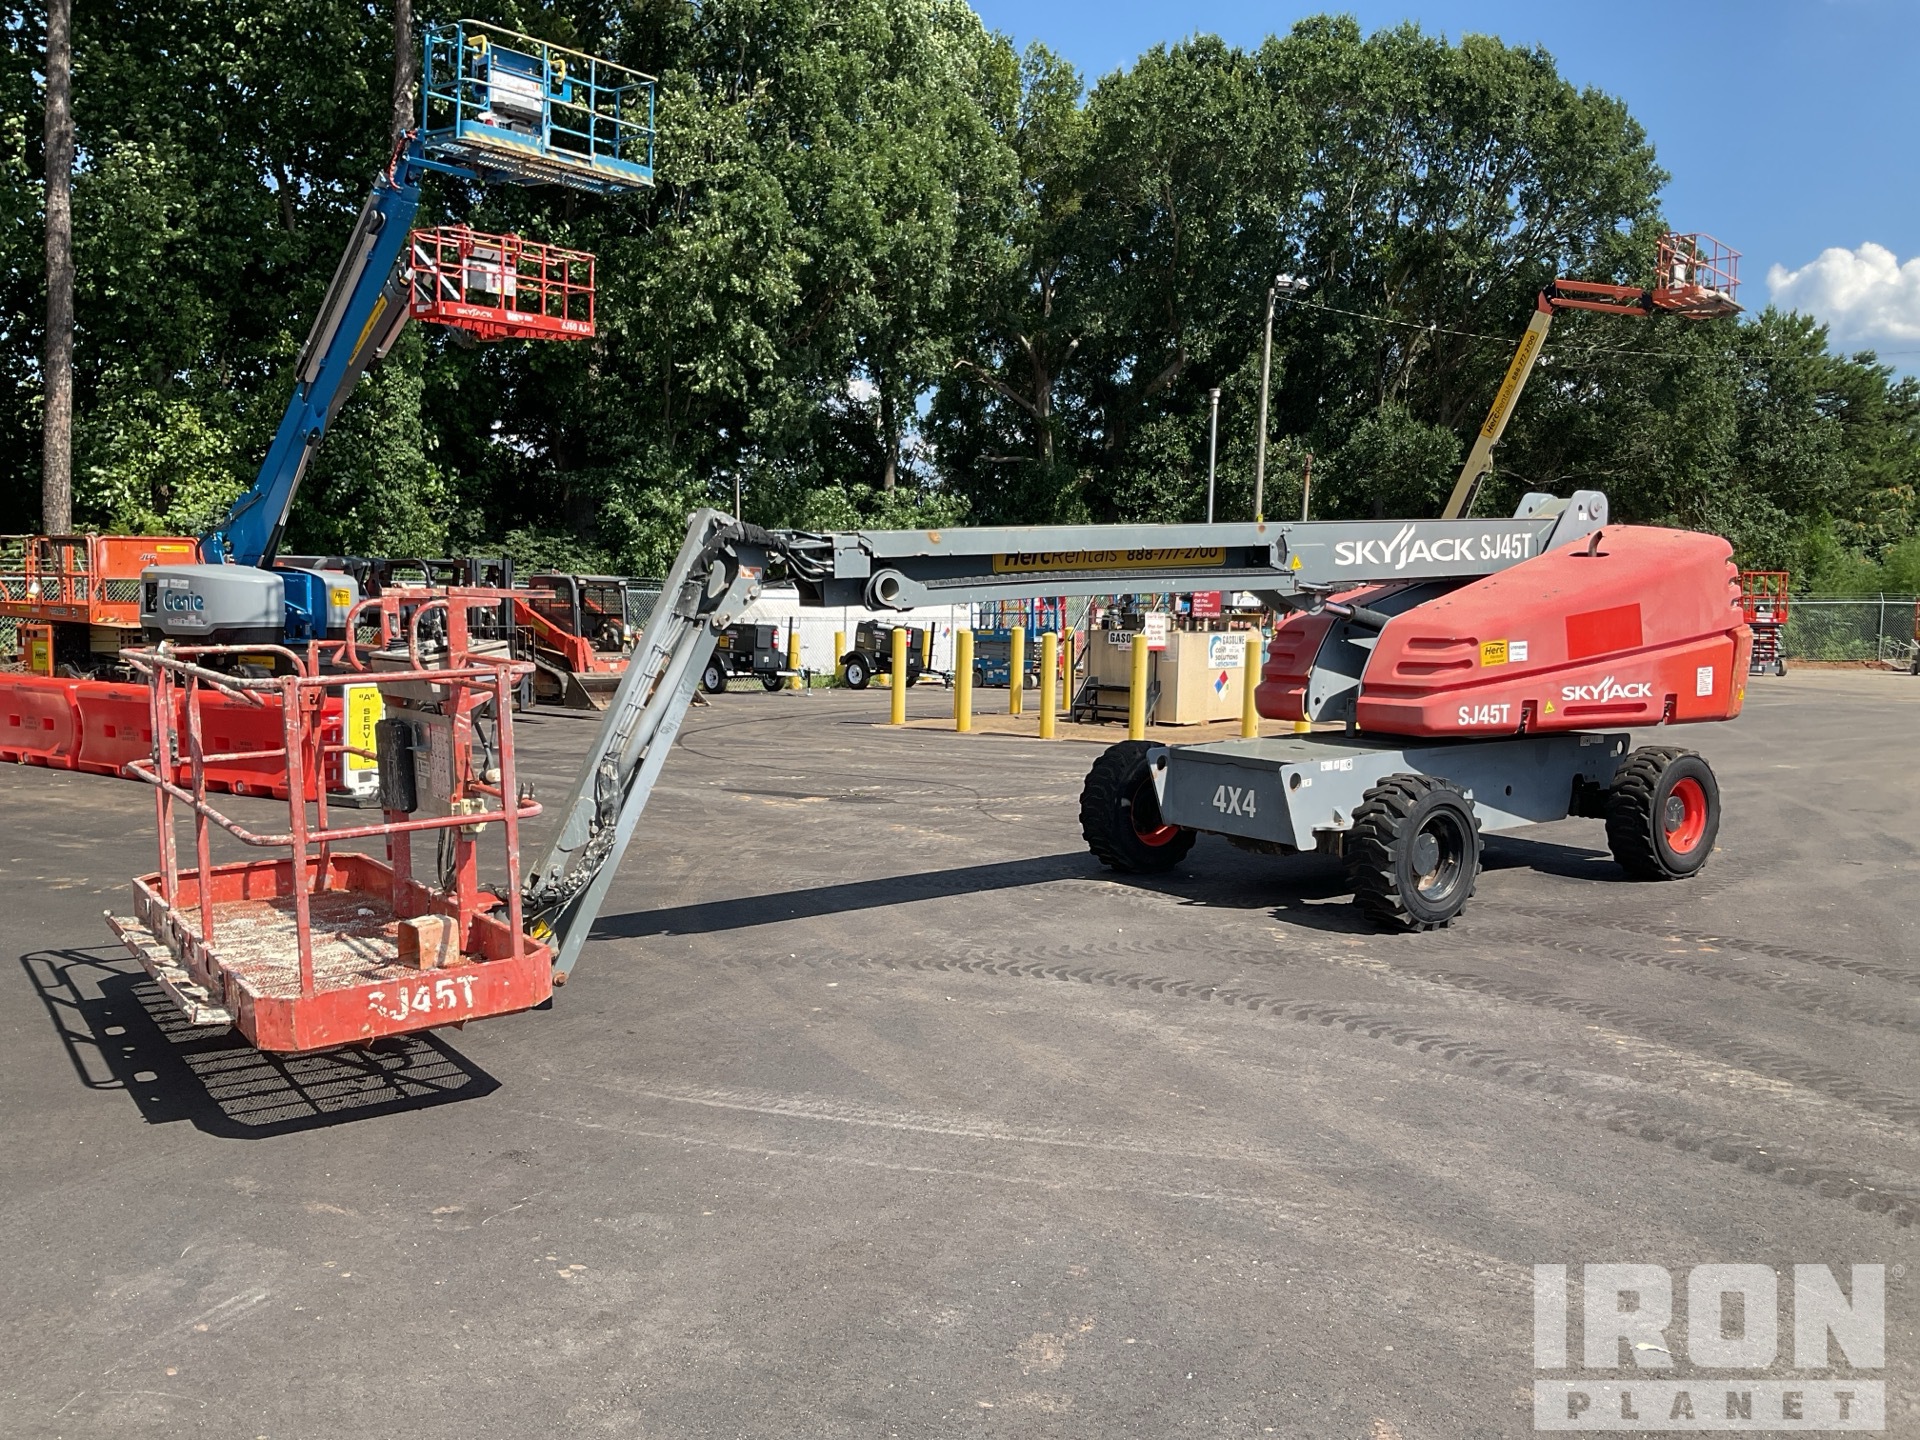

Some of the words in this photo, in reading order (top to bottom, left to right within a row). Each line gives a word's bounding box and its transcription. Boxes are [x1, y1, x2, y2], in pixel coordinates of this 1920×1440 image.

[1511, 335, 1535, 381] 888-777-2700
[1334, 523, 1475, 570] SKYJACK
[1480, 532, 1532, 560] SJ45T
[163, 590, 204, 611] Genie
[1110, 632, 1135, 643] GASO
[1485, 646, 1505, 656] Herc
[1561, 676, 1652, 703] SKYJACK
[1457, 704, 1511, 726] SJ45T
[363, 708, 371, 763] SERVIE
[1212, 785, 1257, 818] 4X4
